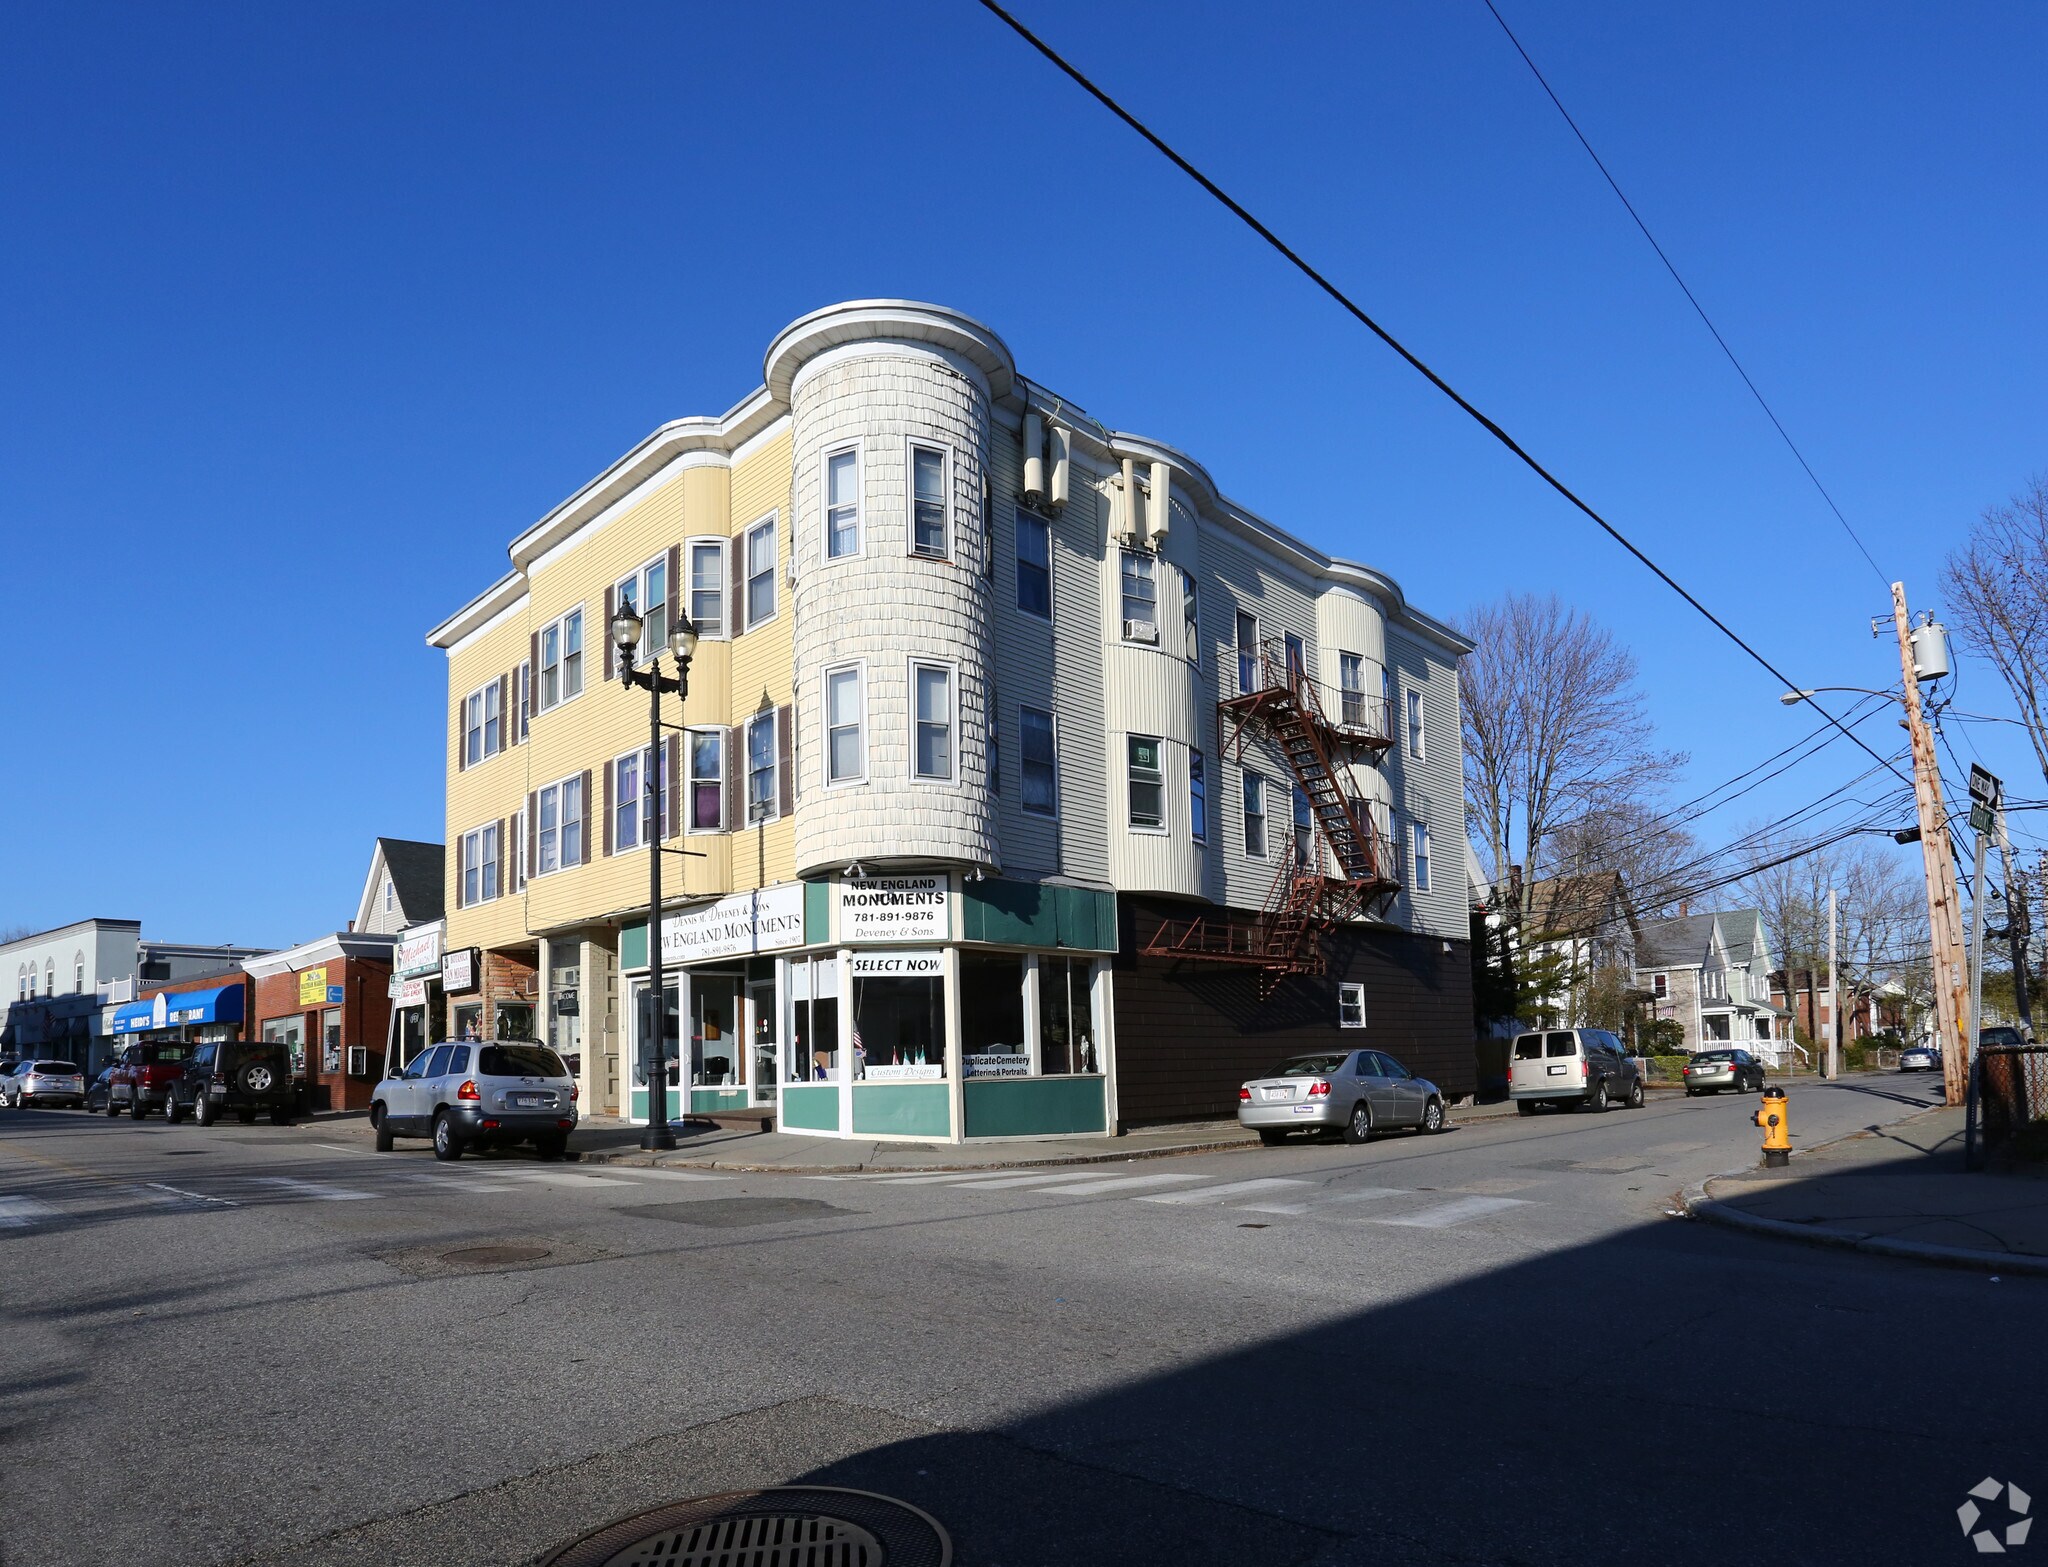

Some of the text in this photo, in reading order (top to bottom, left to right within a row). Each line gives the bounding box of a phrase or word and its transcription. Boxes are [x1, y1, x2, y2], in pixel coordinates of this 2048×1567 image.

[851, 879, 936, 890] NEW ENGLAND
[843, 892, 944, 907] MONUMENTS
[672, 913, 698, 928] DENNIS
[708, 905, 740, 922] DEVENEY
[742, 904, 748, 916] &
[854, 911, 934, 922] 781-891-9876
[673, 927, 722, 948] ENGLAND
[724, 913, 801, 940] MONUMENTS
[855, 926, 934, 938] Deveney & Sons
[775, 938, 788, 946] Since
[402, 935, 431, 964] Michael
[450, 952, 468, 964] BOTANICA
[854, 960, 942, 971] SELECT NOW
[444, 968, 453, 981] SAN
[453, 966, 470, 980] MIGUEL
[169, 1008, 204, 1023] RESRANT
[130, 1016, 150, 1028] HEIDI'S
[870, 1068, 935, 1079] Custom Designs
[1001, 1067, 1027, 1076] Portraits
